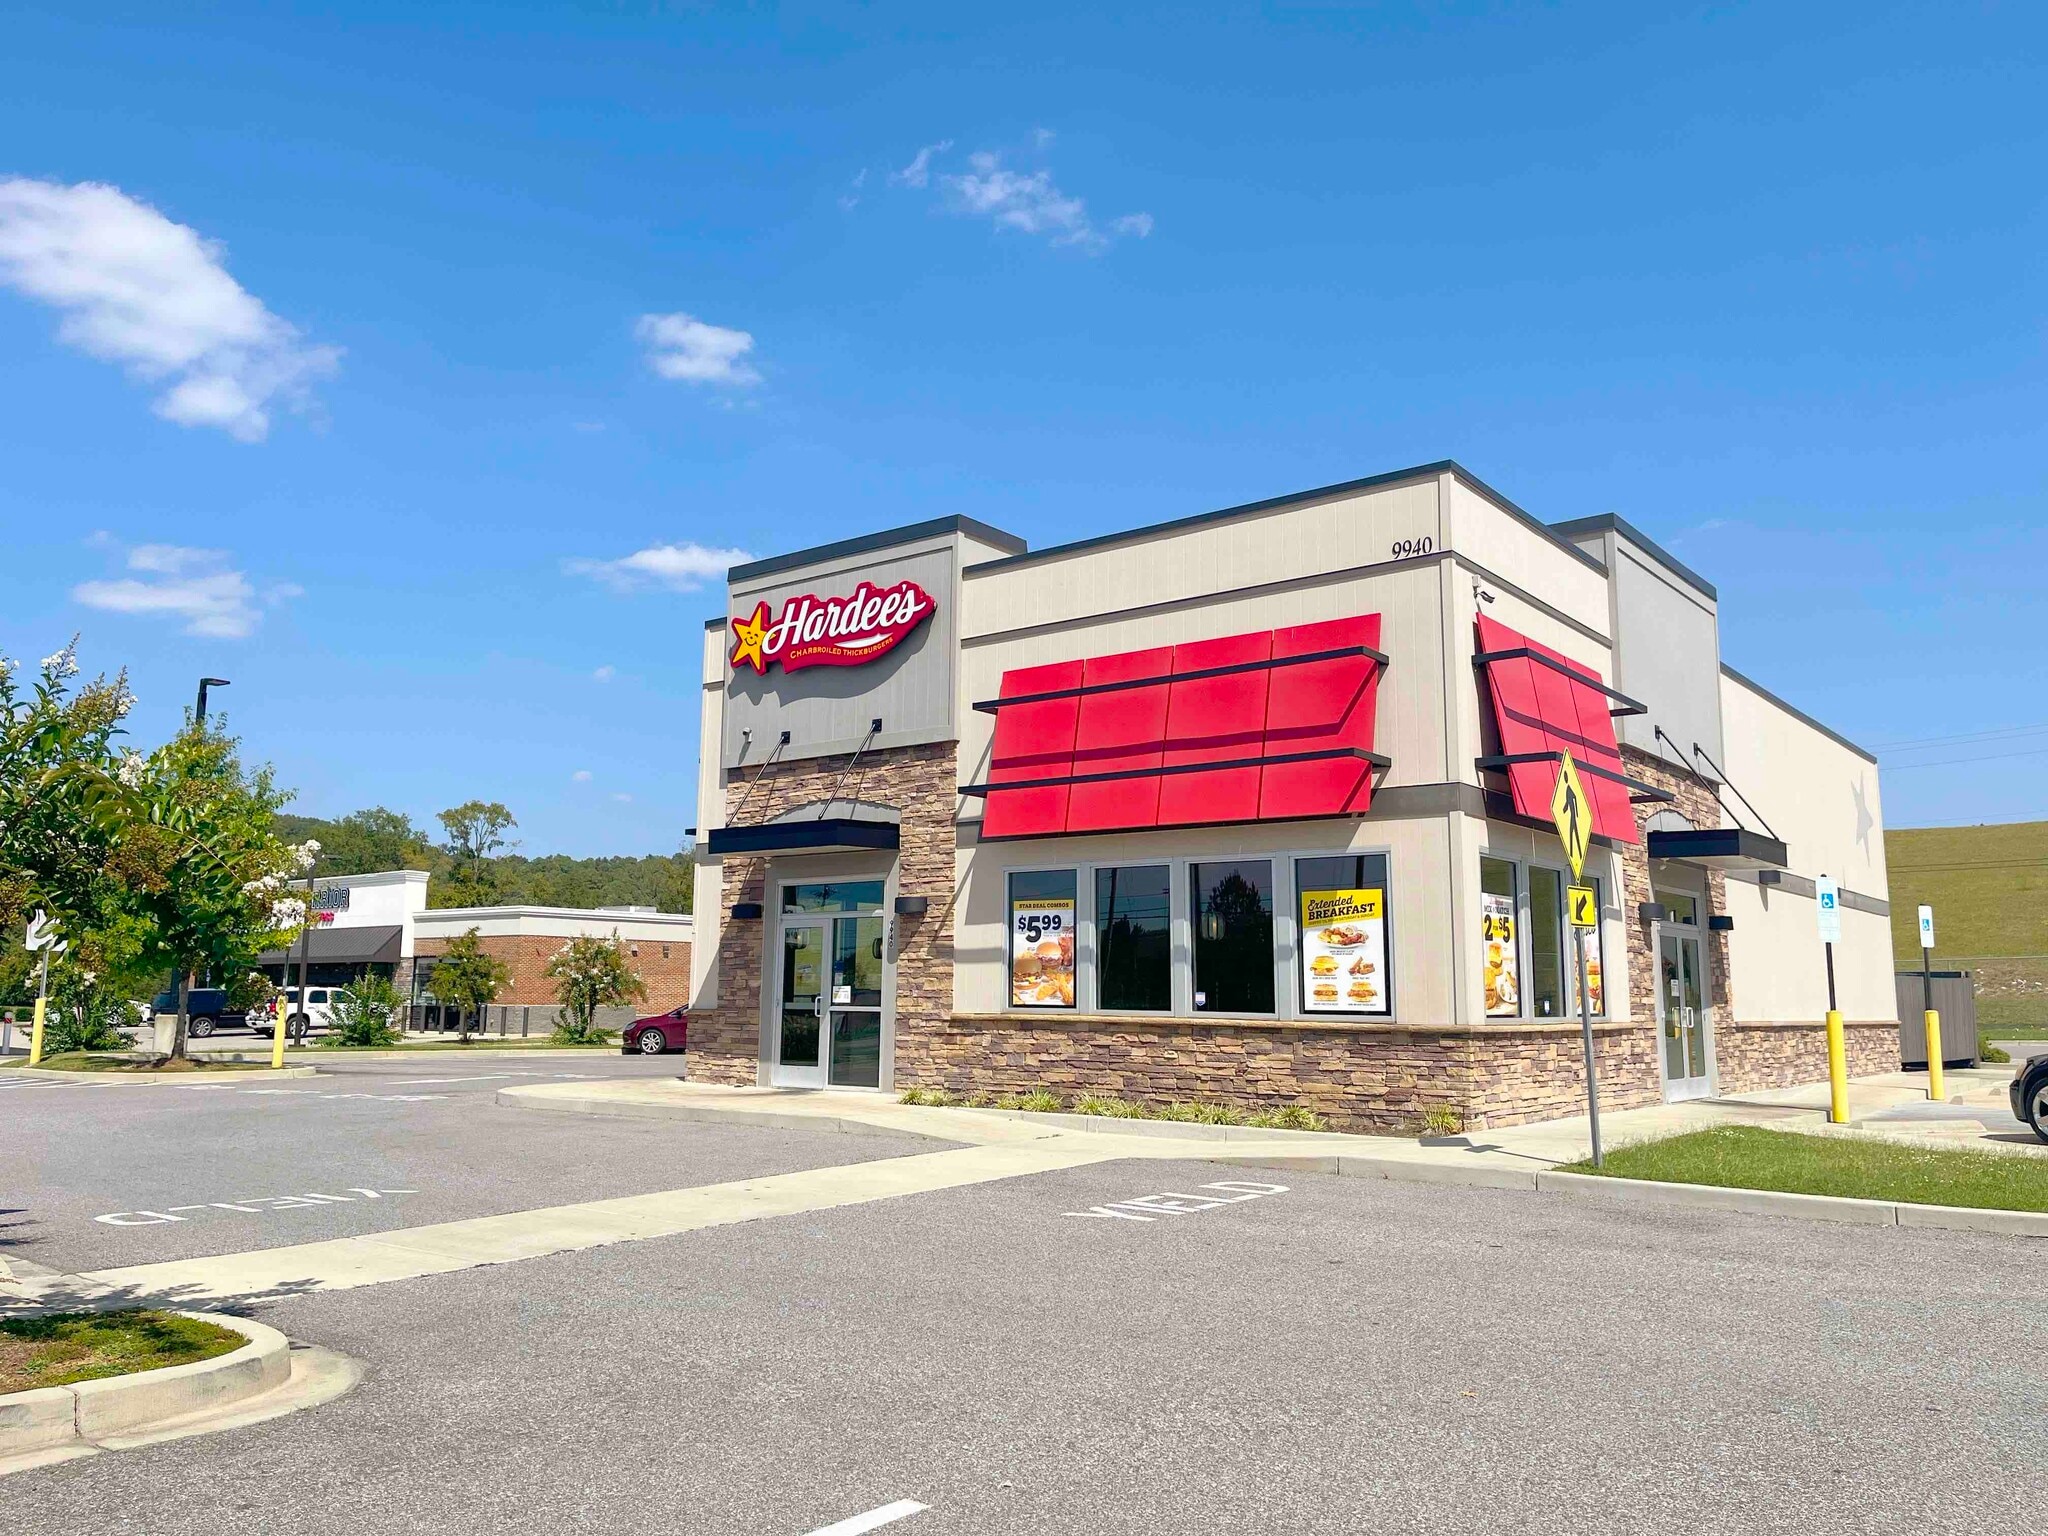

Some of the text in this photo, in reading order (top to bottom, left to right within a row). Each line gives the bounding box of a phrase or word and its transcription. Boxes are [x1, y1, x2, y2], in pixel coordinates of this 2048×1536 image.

[1391, 536, 1433, 560] 9940
[761, 584, 926, 654] Hardee's
[790, 637, 893, 659] CHARBROILED THICKBURGERS
[1307, 895, 1354, 911] Extended
[1308, 902, 1375, 921] BREAKFAST
[1484, 914, 1493, 941] 2
[1060, 1181, 1291, 1222] YIELD
